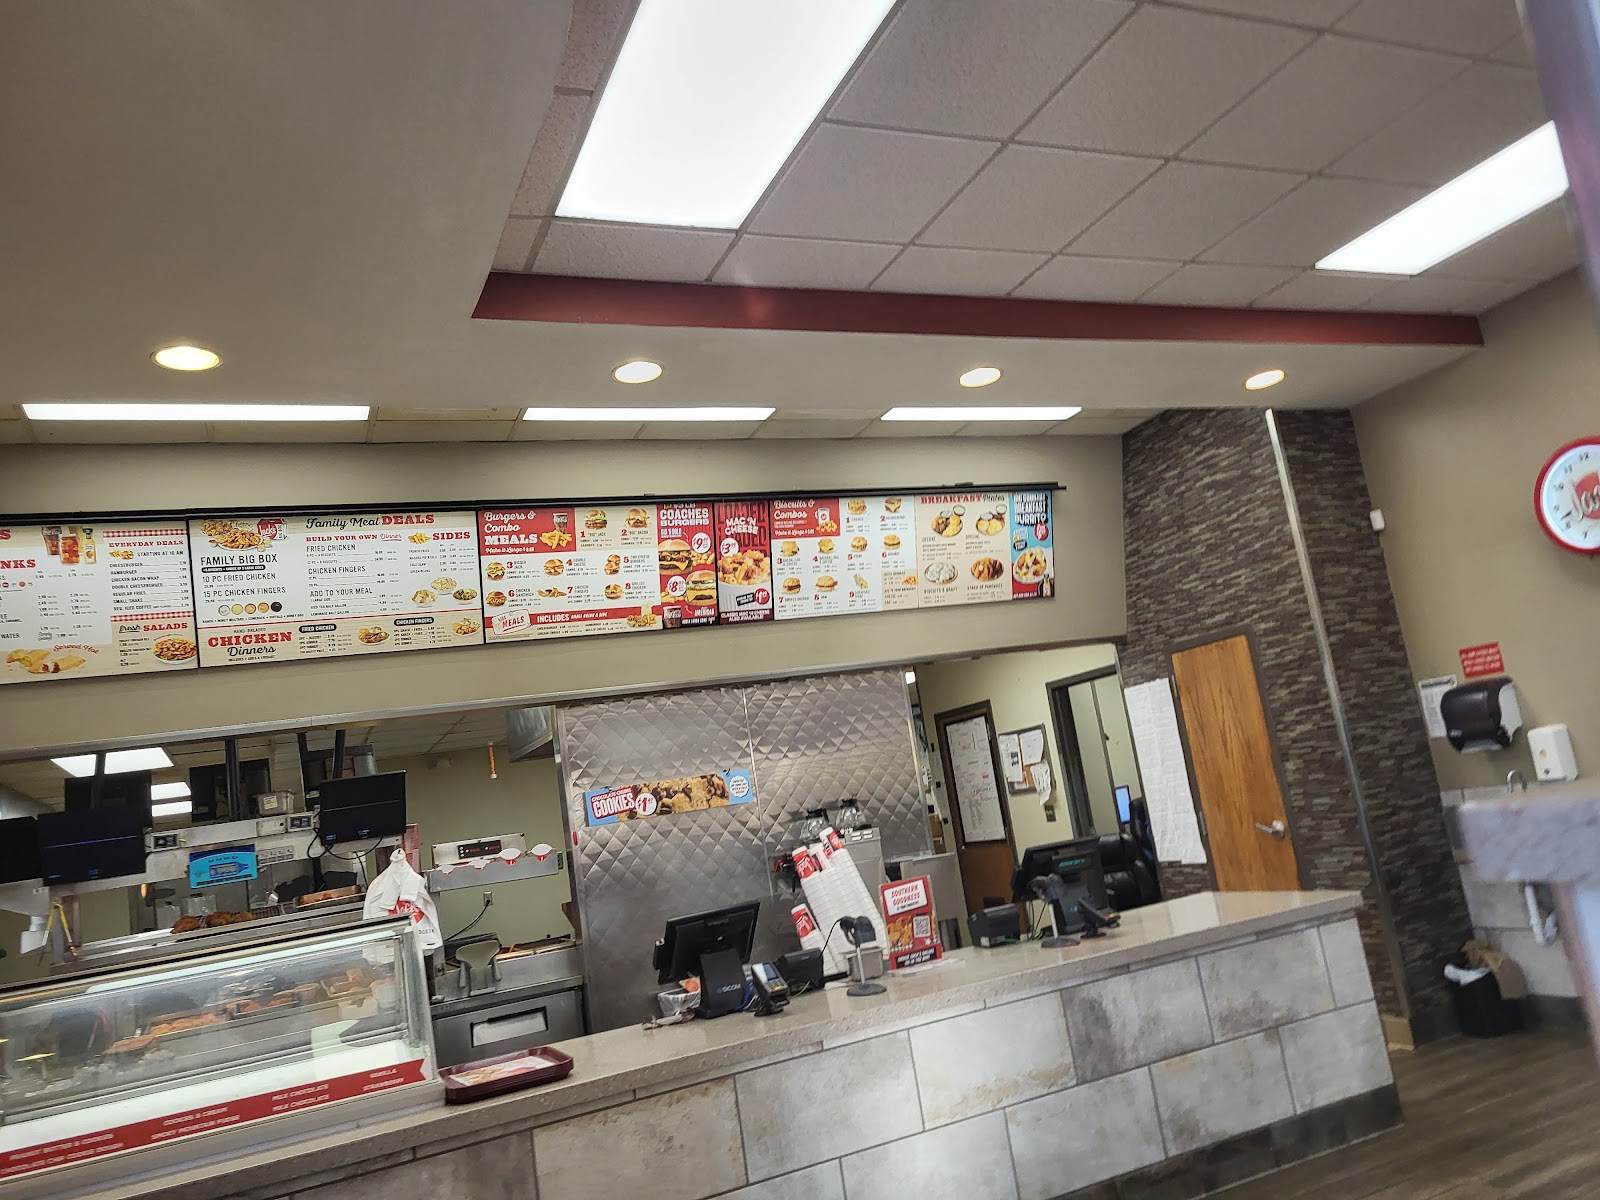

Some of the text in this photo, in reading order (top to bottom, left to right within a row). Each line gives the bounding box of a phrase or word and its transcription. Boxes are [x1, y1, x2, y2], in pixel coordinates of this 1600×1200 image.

[1580, 452, 1589, 461] 12
[774, 499, 815, 509] Biscuits &
[920, 494, 982, 504] BREAKFAST
[983, 494, 1004, 503] Plates
[1014, 501, 1047, 513] BREAKFAST
[484, 511, 536, 523] Burgers &
[660, 508, 709, 520] COACHES
[774, 510, 807, 520] Combos
[1015, 513, 1047, 525] BURRITO
[306, 514, 435, 530] Family Meal DEALS
[660, 519, 709, 527] BURGERS
[726, 517, 746, 528] MAC
[484, 523, 521, 533] Combo
[725, 525, 758, 535] CHEESE
[432, 532, 470, 541] SIDES
[485, 534, 538, 545] MEALS
[201, 554, 278, 566] FAMILY BIG BOX
[626, 582, 631, 590] 8
[225, 588, 255, 597] CHICKEN
[779, 596, 784, 604] 7
[502, 616, 525, 628] MEALS
[537, 614, 569, 623] INCLUDES
[143, 622, 188, 631] SALADS
[208, 632, 292, 647] CHICKEN
[227, 646, 276, 656] Dinners
[591, 790, 617, 802] CHOCOLATE
[592, 792, 635, 818] COOKIES
[891, 884, 918, 899] SOUTHERN
[893, 892, 920, 907] GOODNESS
[369, 1068, 397, 1079] VANILLA
[362, 1077, 405, 1091] STRAWBERRY
[272, 1084, 329, 1101] MILK CHOCOLATE
[272, 1094, 329, 1112] MILK CHOCOLATE
[202, 1107, 228, 1117] CREAM
[217, 1114, 240, 1125] FUDGE
